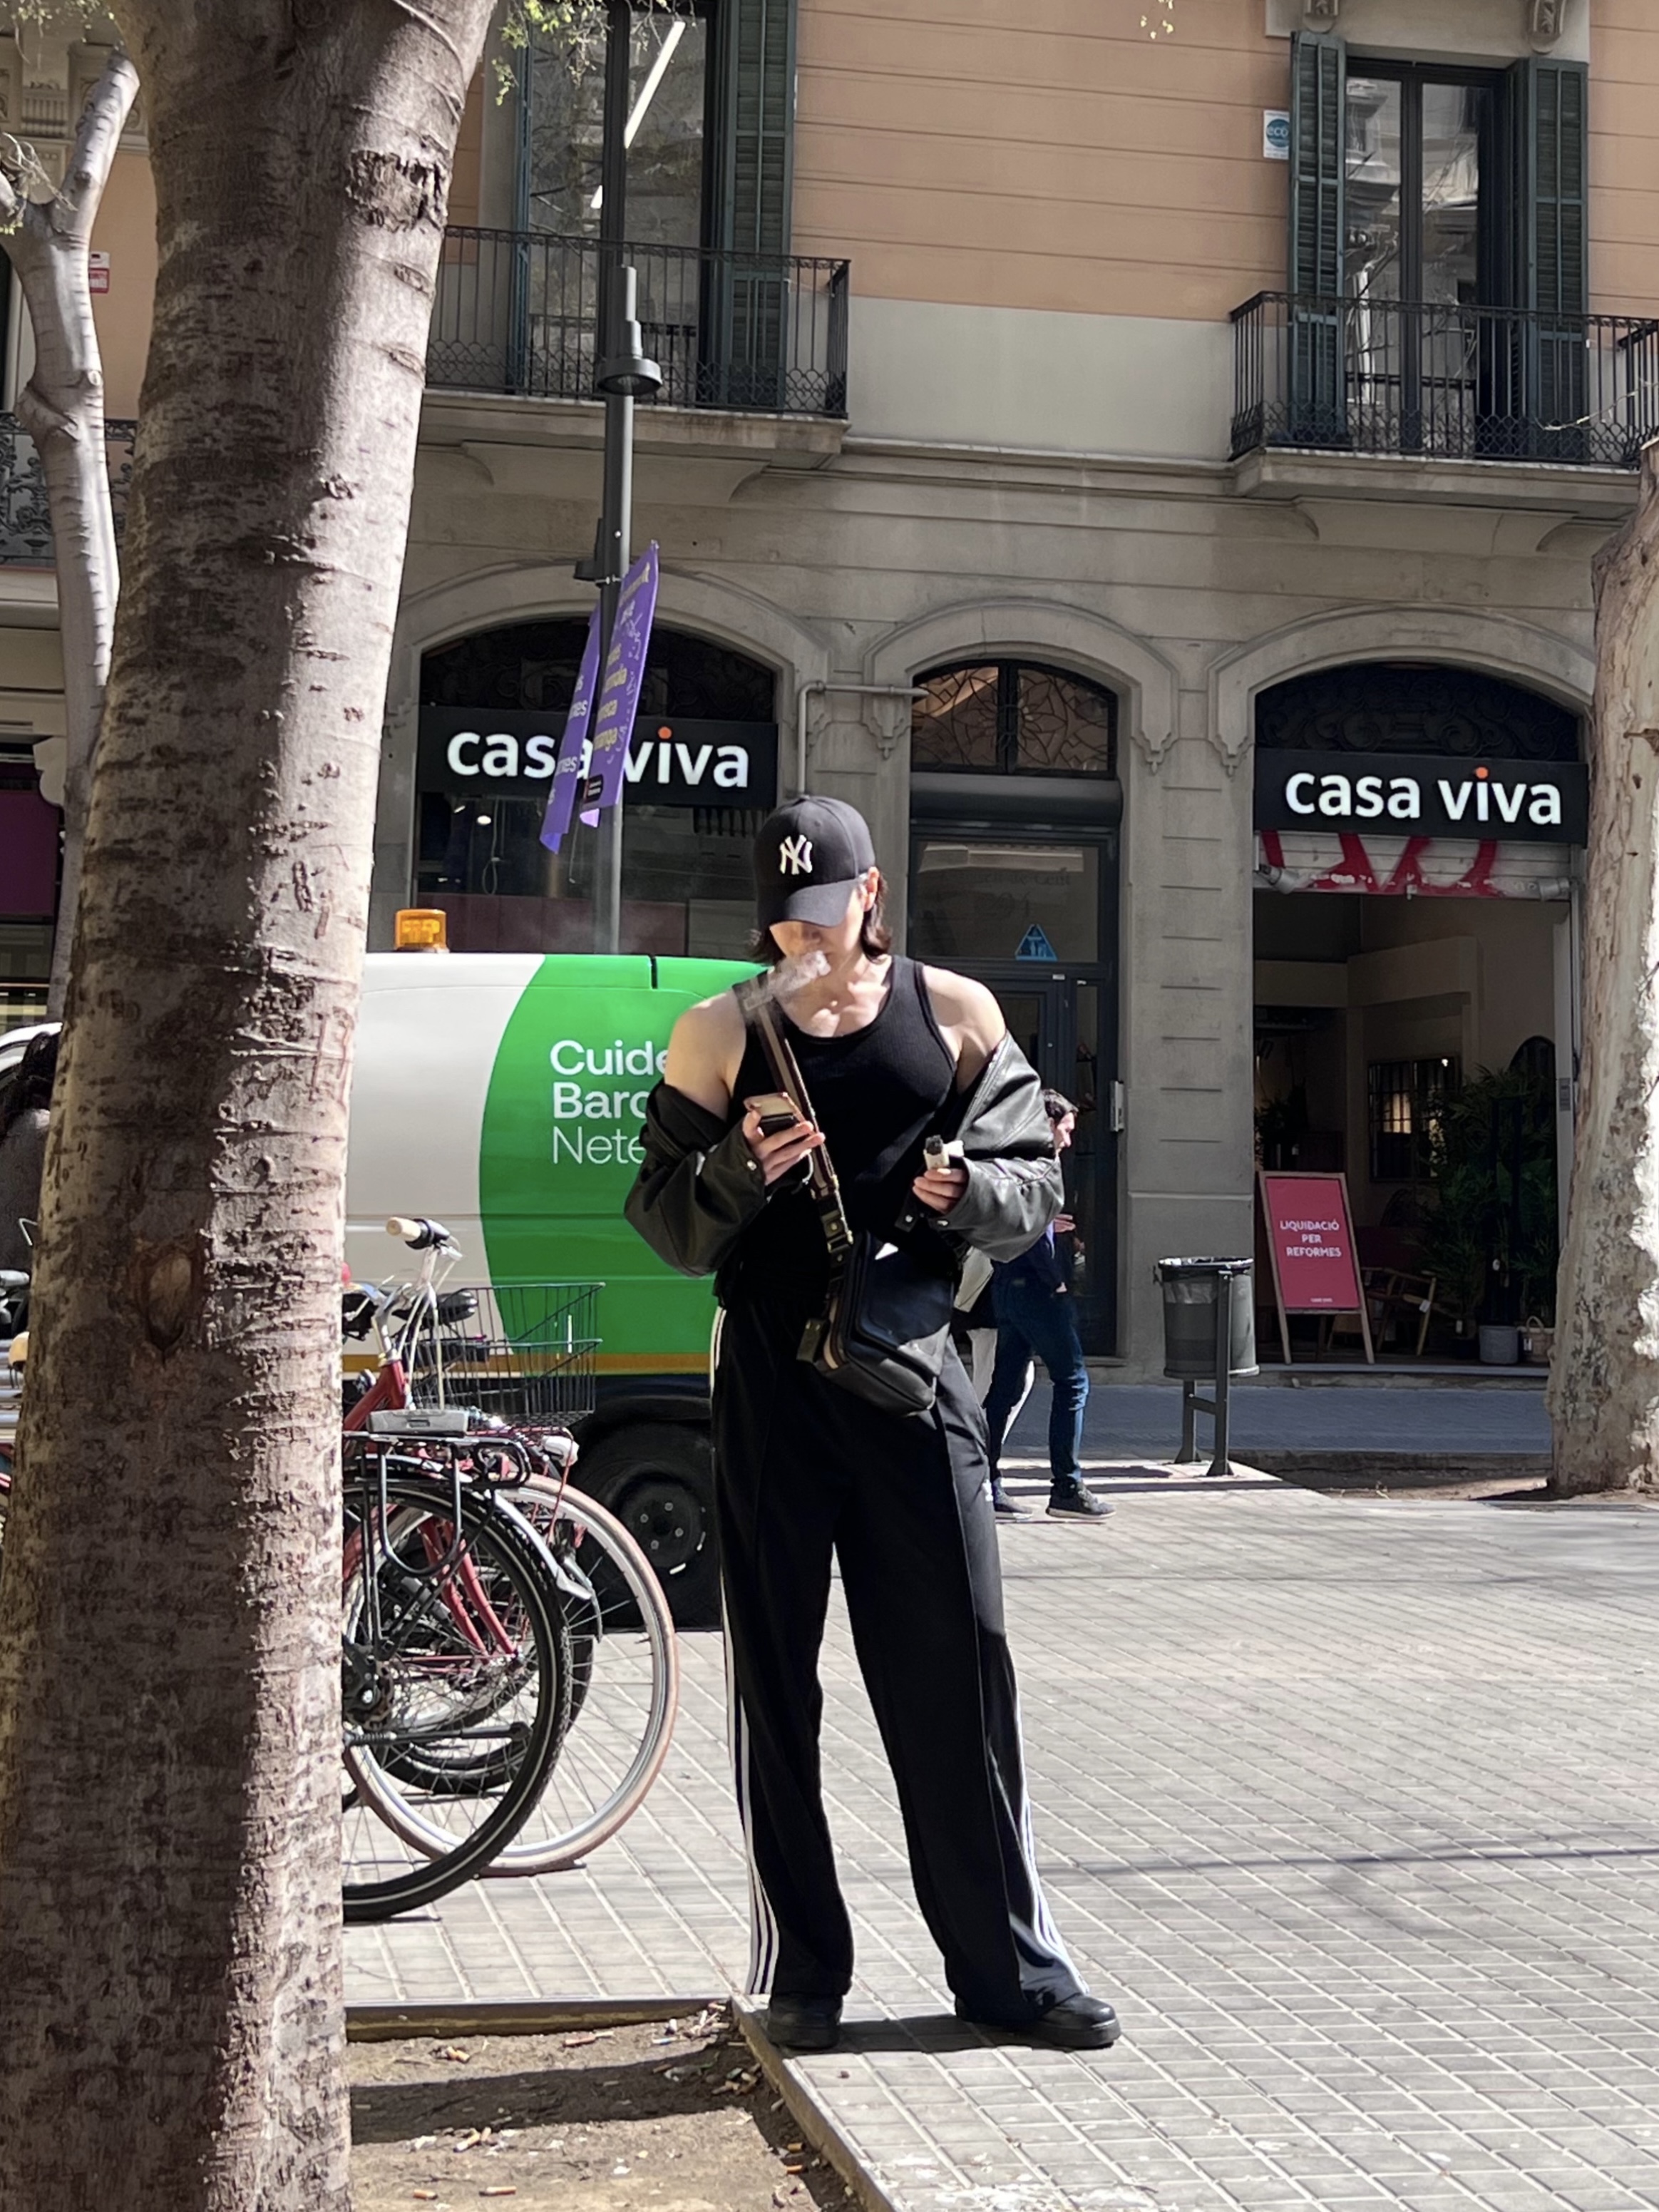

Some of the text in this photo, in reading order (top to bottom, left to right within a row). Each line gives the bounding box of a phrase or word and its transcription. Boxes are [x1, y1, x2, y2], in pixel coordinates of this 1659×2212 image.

[625, 727, 749, 788] viva
[1285, 767, 1561, 825] casa viva
[779, 834, 813, 875] NY
[1280, 1219, 1340, 1232] LIQUIDACIÓ
[1301, 1234, 1322, 1244] PER
[1286, 1246, 1342, 1258] REFORMES
